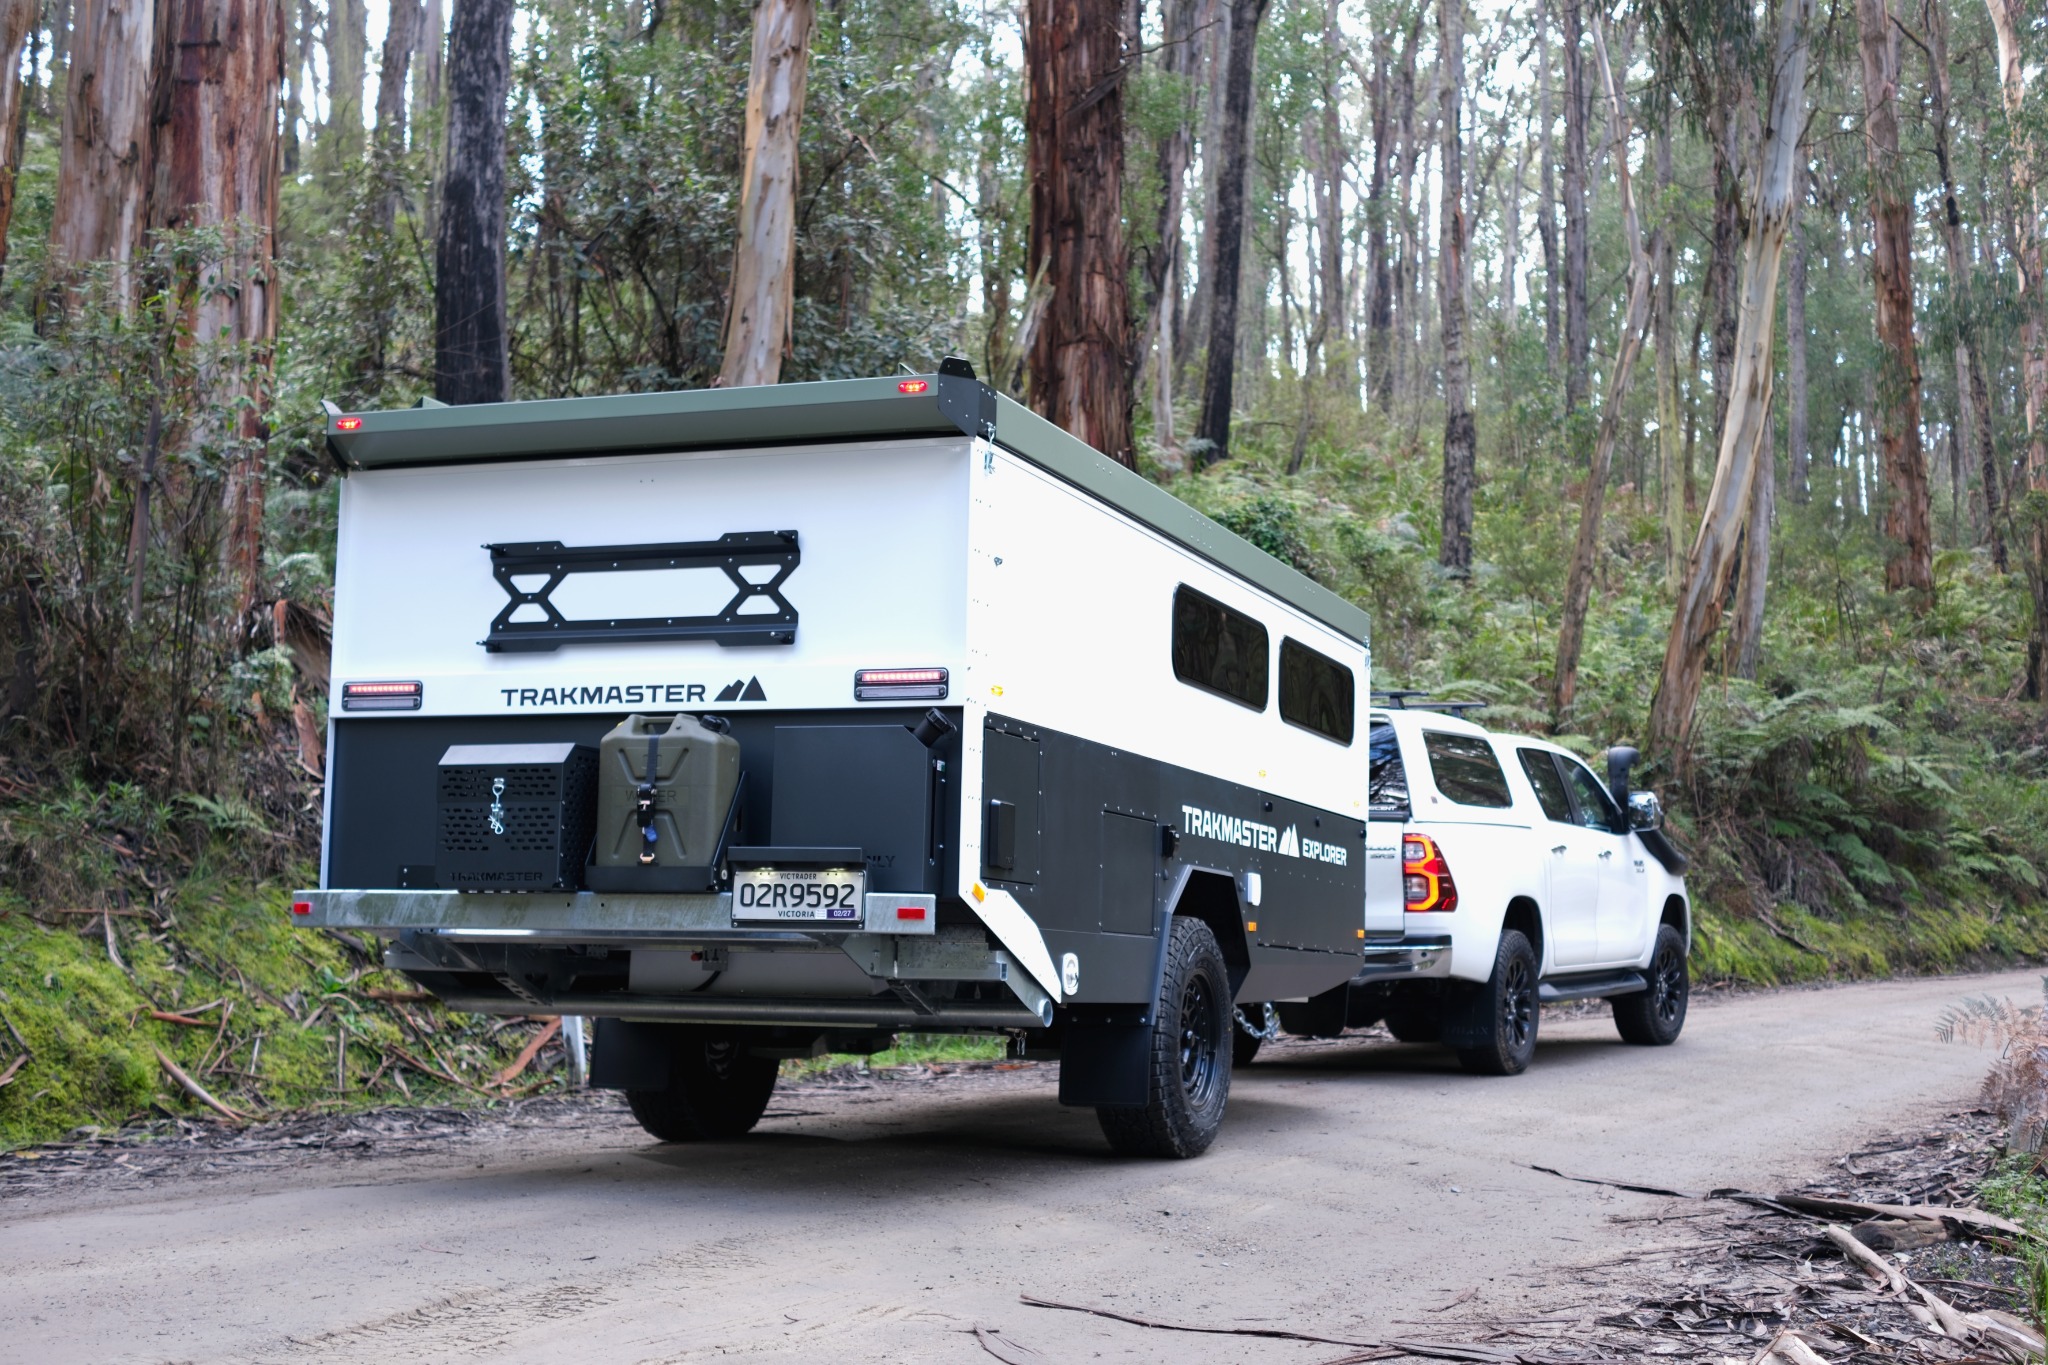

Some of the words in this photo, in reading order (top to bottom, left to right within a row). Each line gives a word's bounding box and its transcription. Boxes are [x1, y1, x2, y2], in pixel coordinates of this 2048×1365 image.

[501, 684, 706, 707] TRAKMASTER
[626, 790, 677, 803] WER
[1182, 804, 1278, 853] TRAKMASTER
[1302, 837, 1347, 867] EXPLORER
[867, 855, 896, 868] NLY
[449, 872, 543, 881] TRAKMASTER
[740, 883, 855, 908] 02R9592
[777, 910, 815, 918] VICTORIA
